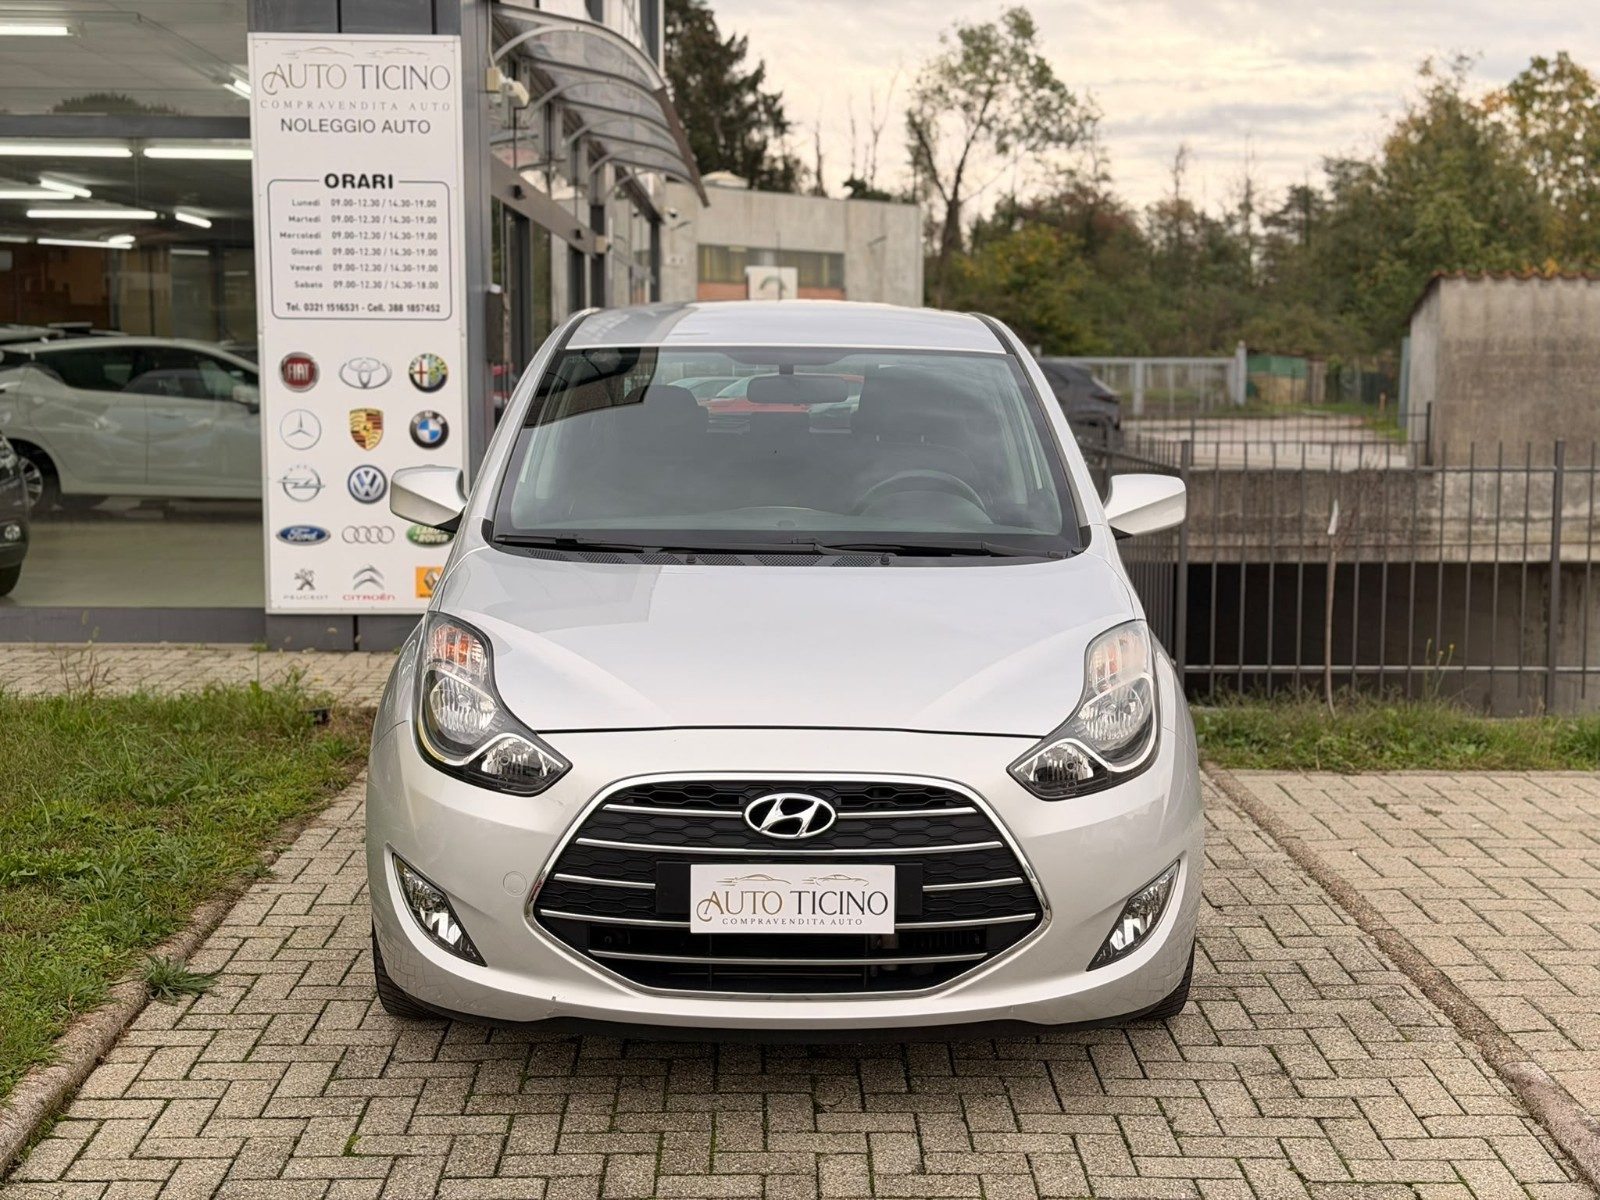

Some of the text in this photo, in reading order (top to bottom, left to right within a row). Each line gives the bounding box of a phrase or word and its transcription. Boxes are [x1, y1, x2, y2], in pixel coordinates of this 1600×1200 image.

[262, 64, 450, 95] AUTO TICINO
[260, 100, 450, 111] COMPRAVENDITA AUTO
[281, 118, 430, 134] NOLEGGIO AUTO
[324, 173, 393, 189] ORARI
[286, 302, 300, 311] Tel.
[304, 303, 323, 311] 0321
[367, 303, 385, 312] Cell.
[389, 304, 403, 312] 388
[287, 363, 310, 381] FIAT
[286, 528, 318, 541] Ford
[696, 890, 888, 922] AUTO TICINO
[830, 918, 863, 926] AUTO
